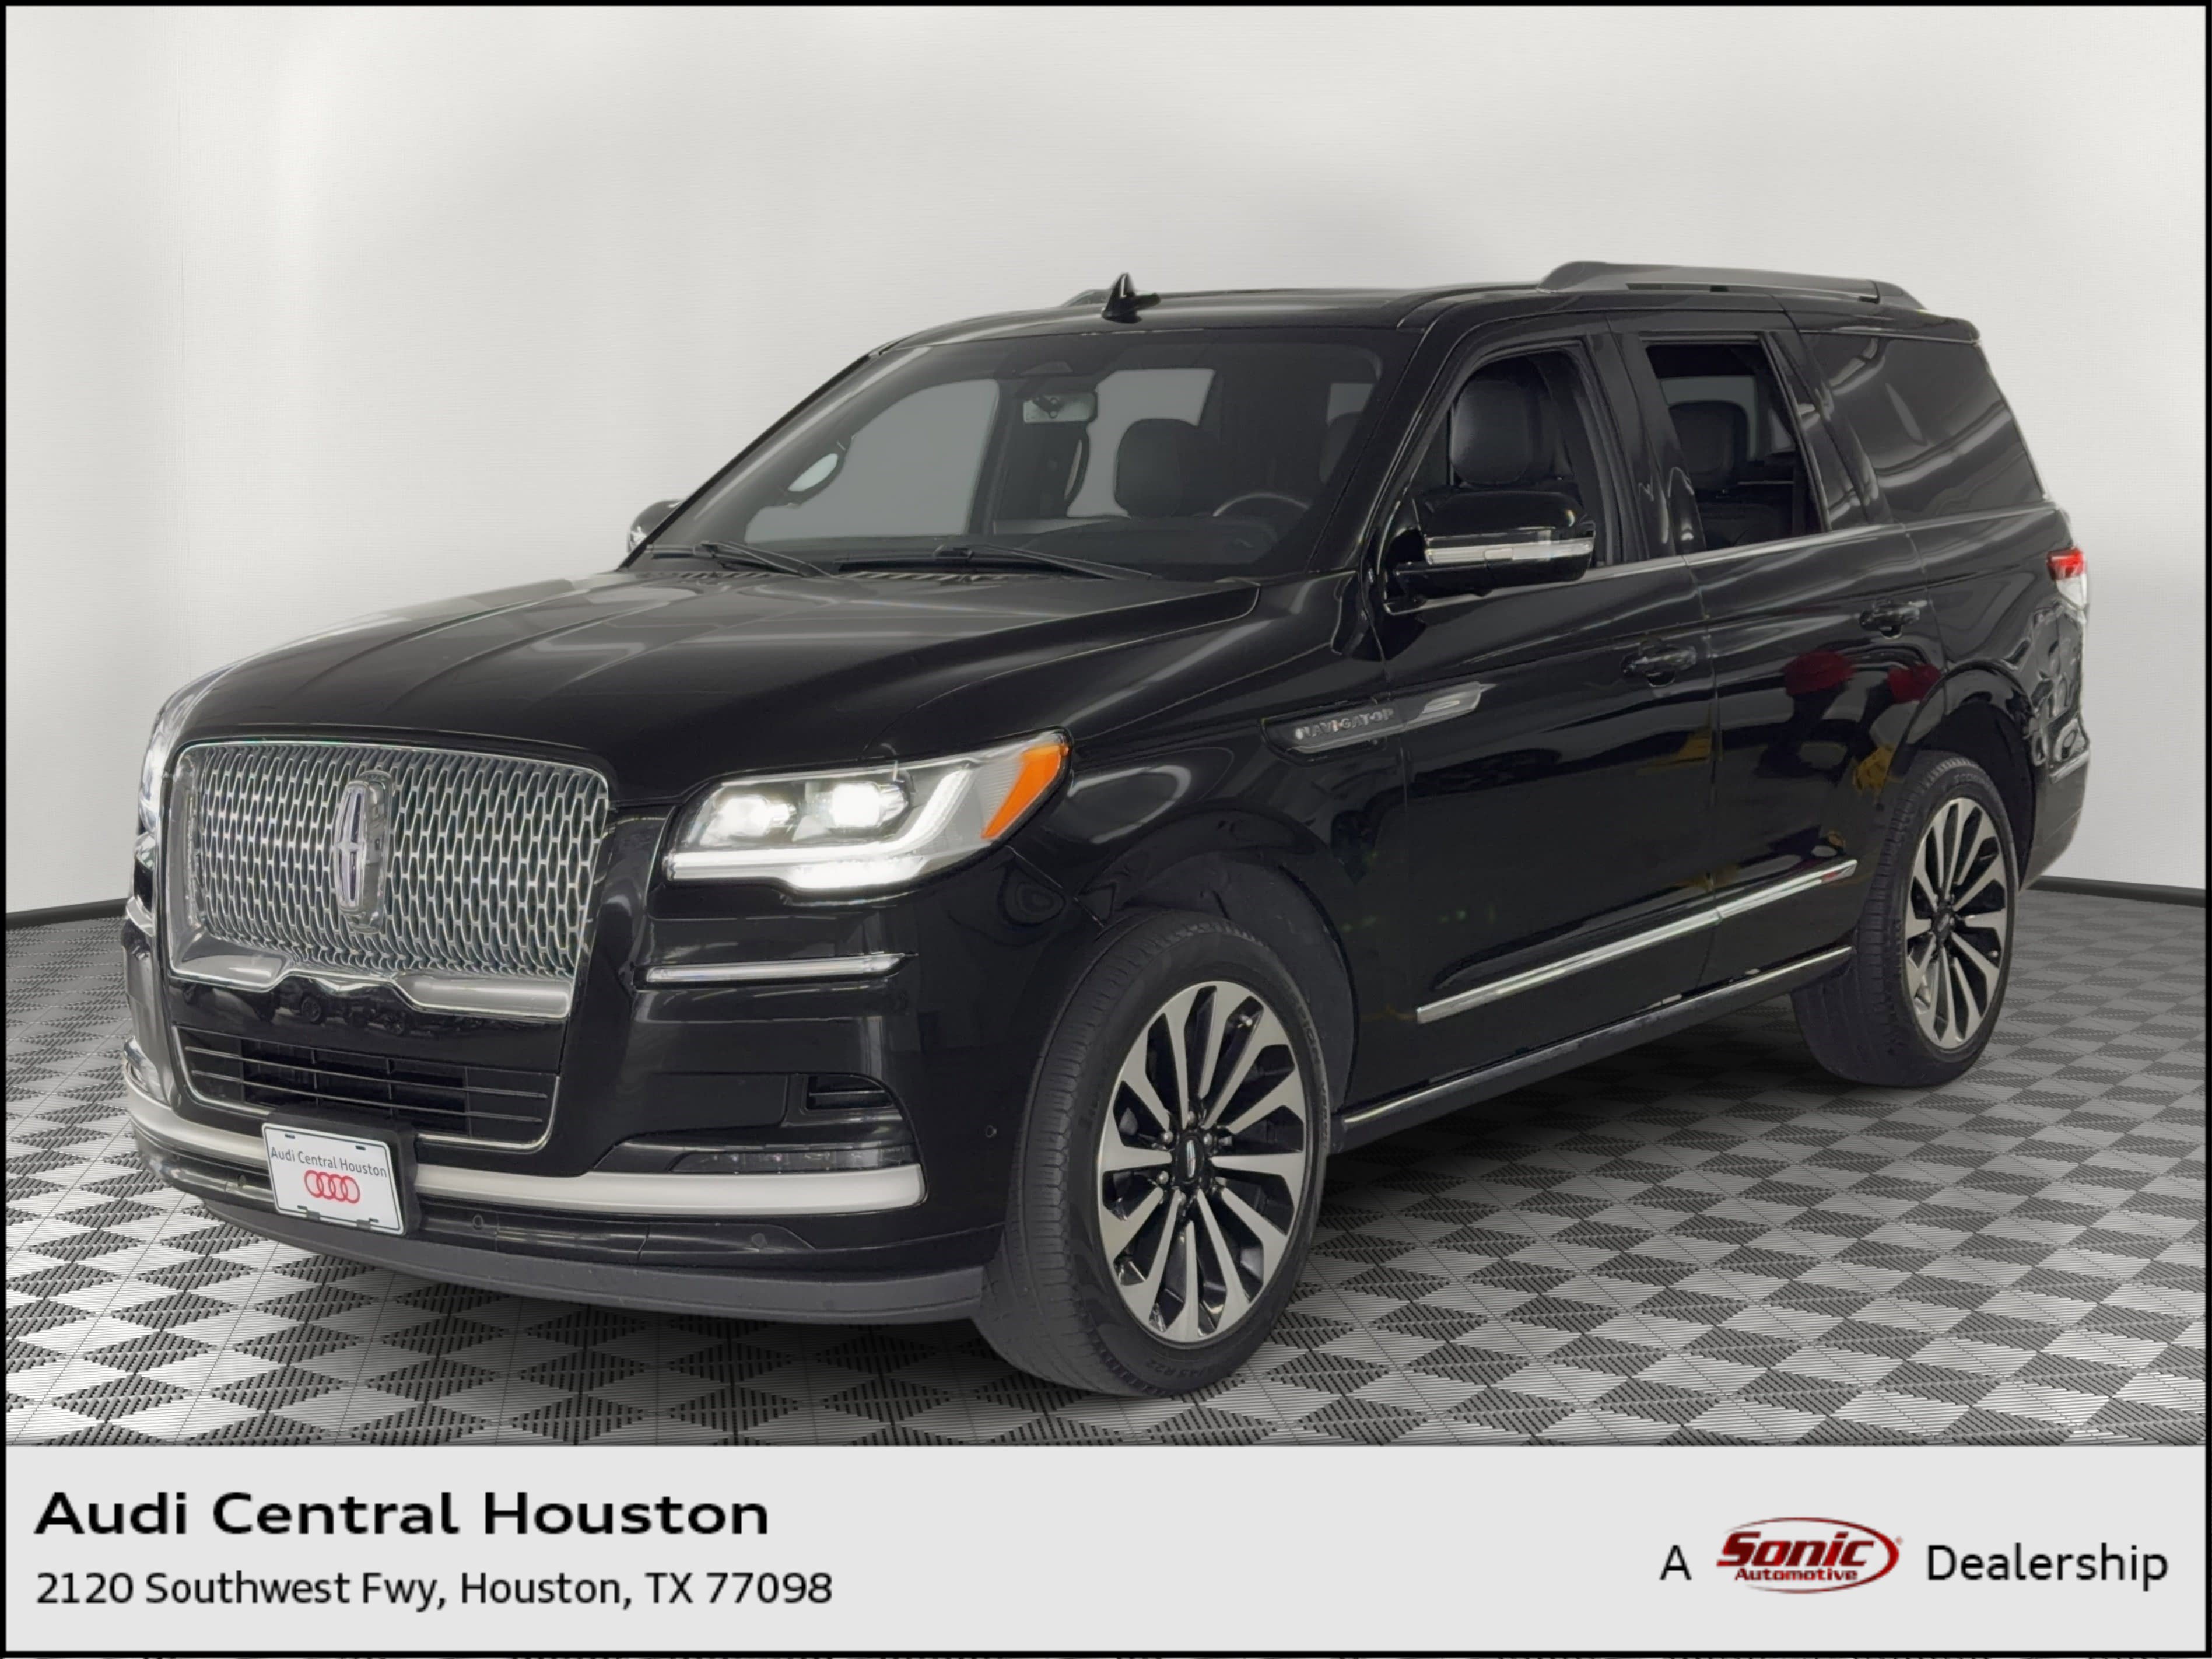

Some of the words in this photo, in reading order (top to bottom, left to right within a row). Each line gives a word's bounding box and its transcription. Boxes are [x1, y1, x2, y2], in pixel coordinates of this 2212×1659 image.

[271, 1146, 296, 1162] Audi
[298, 1152, 338, 1169] Central
[340, 1158, 387, 1177] Houston
